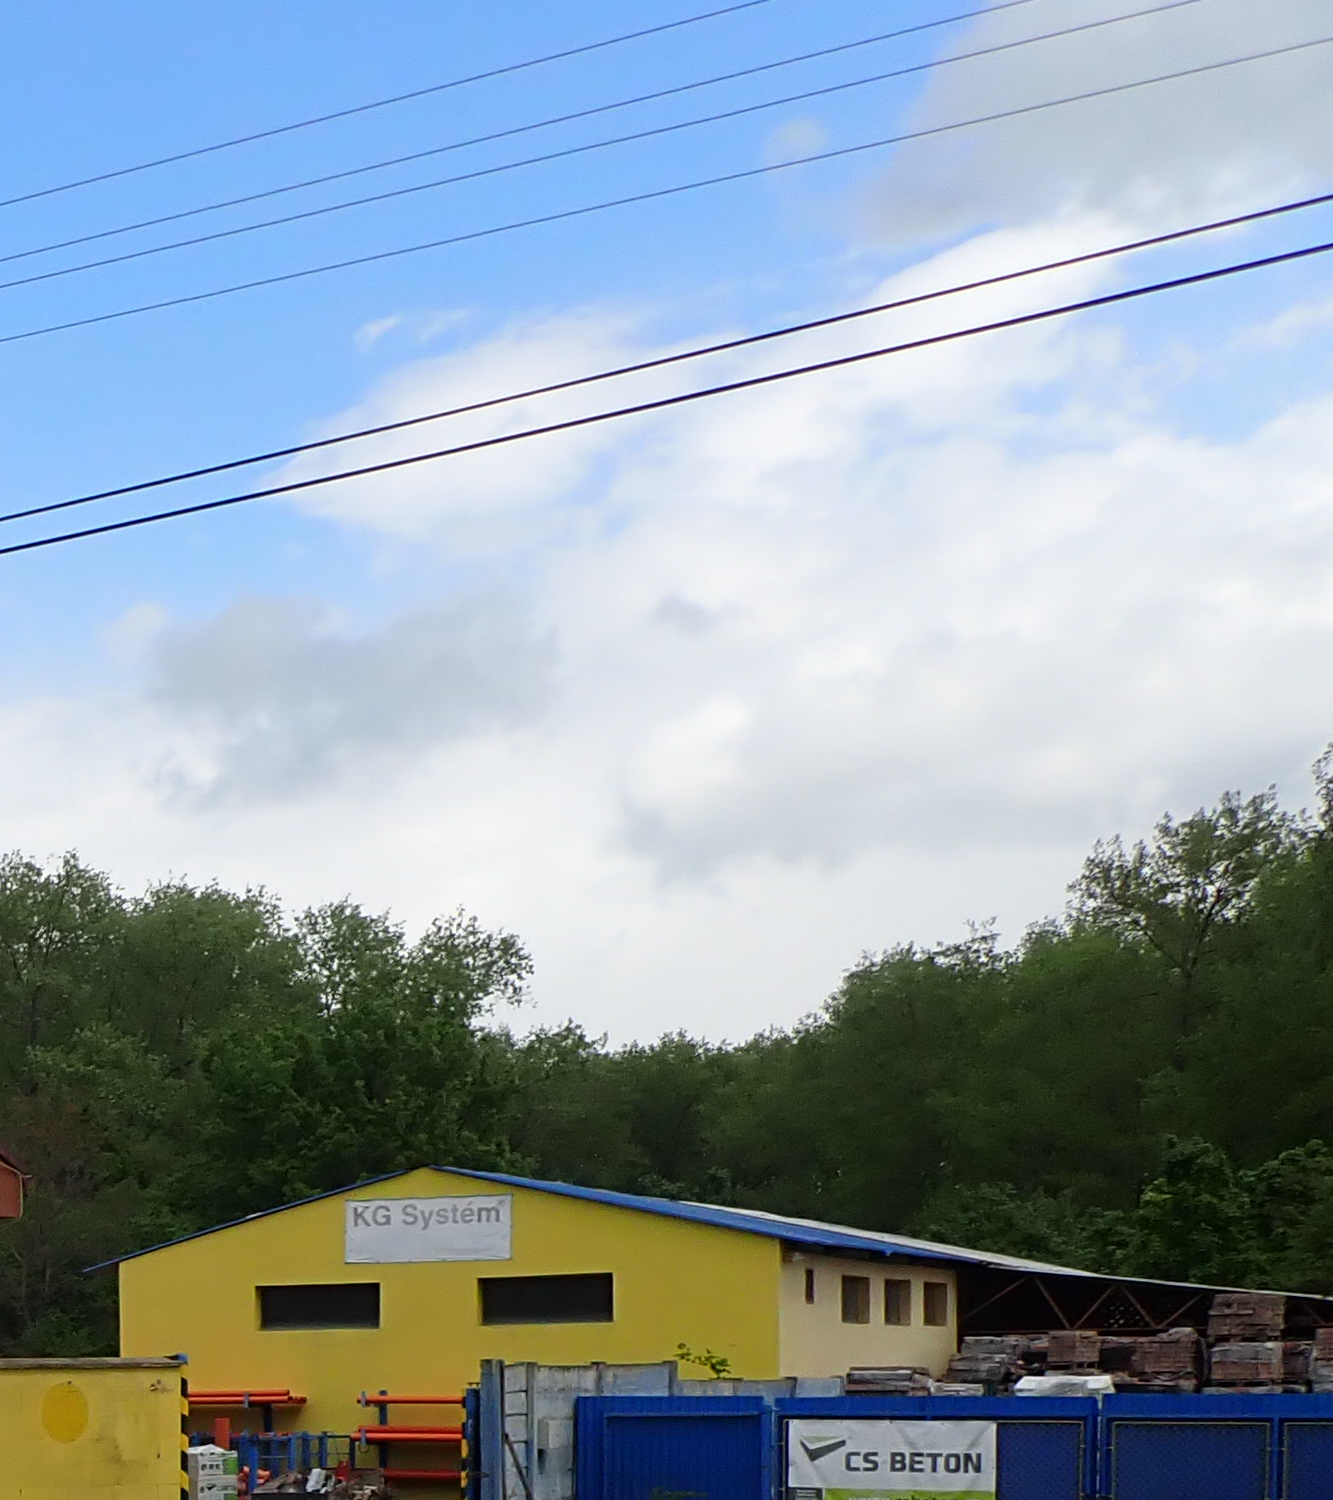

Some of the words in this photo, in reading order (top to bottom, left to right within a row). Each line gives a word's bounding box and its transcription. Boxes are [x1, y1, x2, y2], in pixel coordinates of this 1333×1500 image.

[353, 1205, 392, 1227] KG
[402, 1201, 501, 1230] Systém
[844, 1451, 879, 1472] CS
[890, 1452, 982, 1473] BETON
